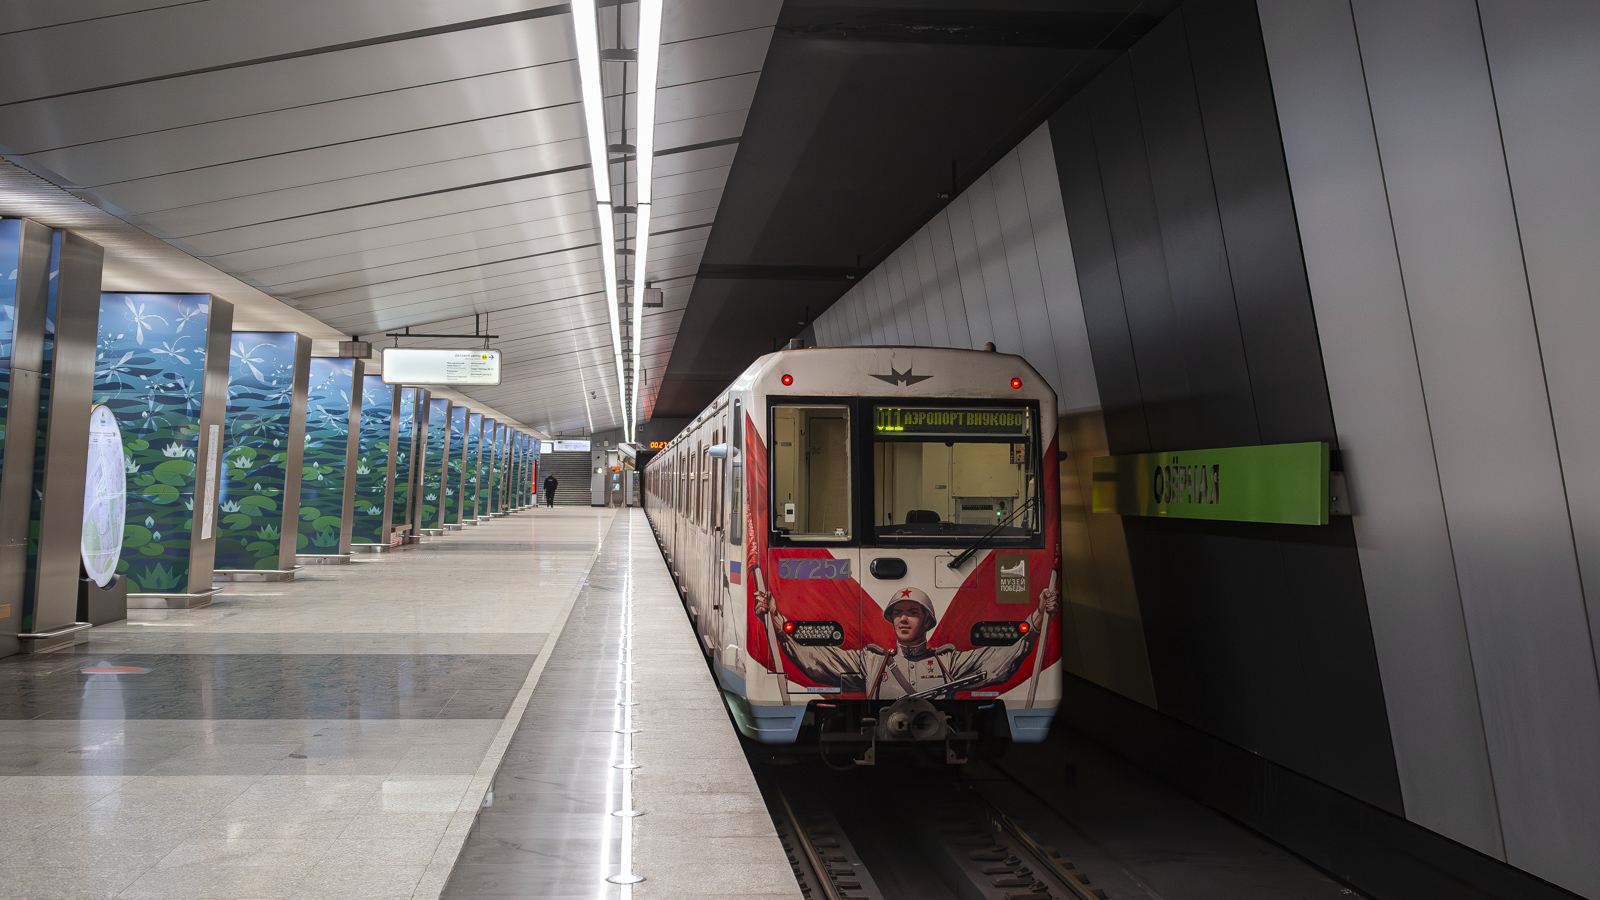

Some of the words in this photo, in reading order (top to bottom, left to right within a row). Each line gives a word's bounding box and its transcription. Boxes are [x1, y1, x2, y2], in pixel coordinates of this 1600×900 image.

[904, 412, 964, 425] АЭРОПОРТ
[966, 412, 1022, 426] ВНУКОВО
[1154, 456, 1219, 504] ОЗЁРНАЯ
[779, 558, 852, 579] 37254
